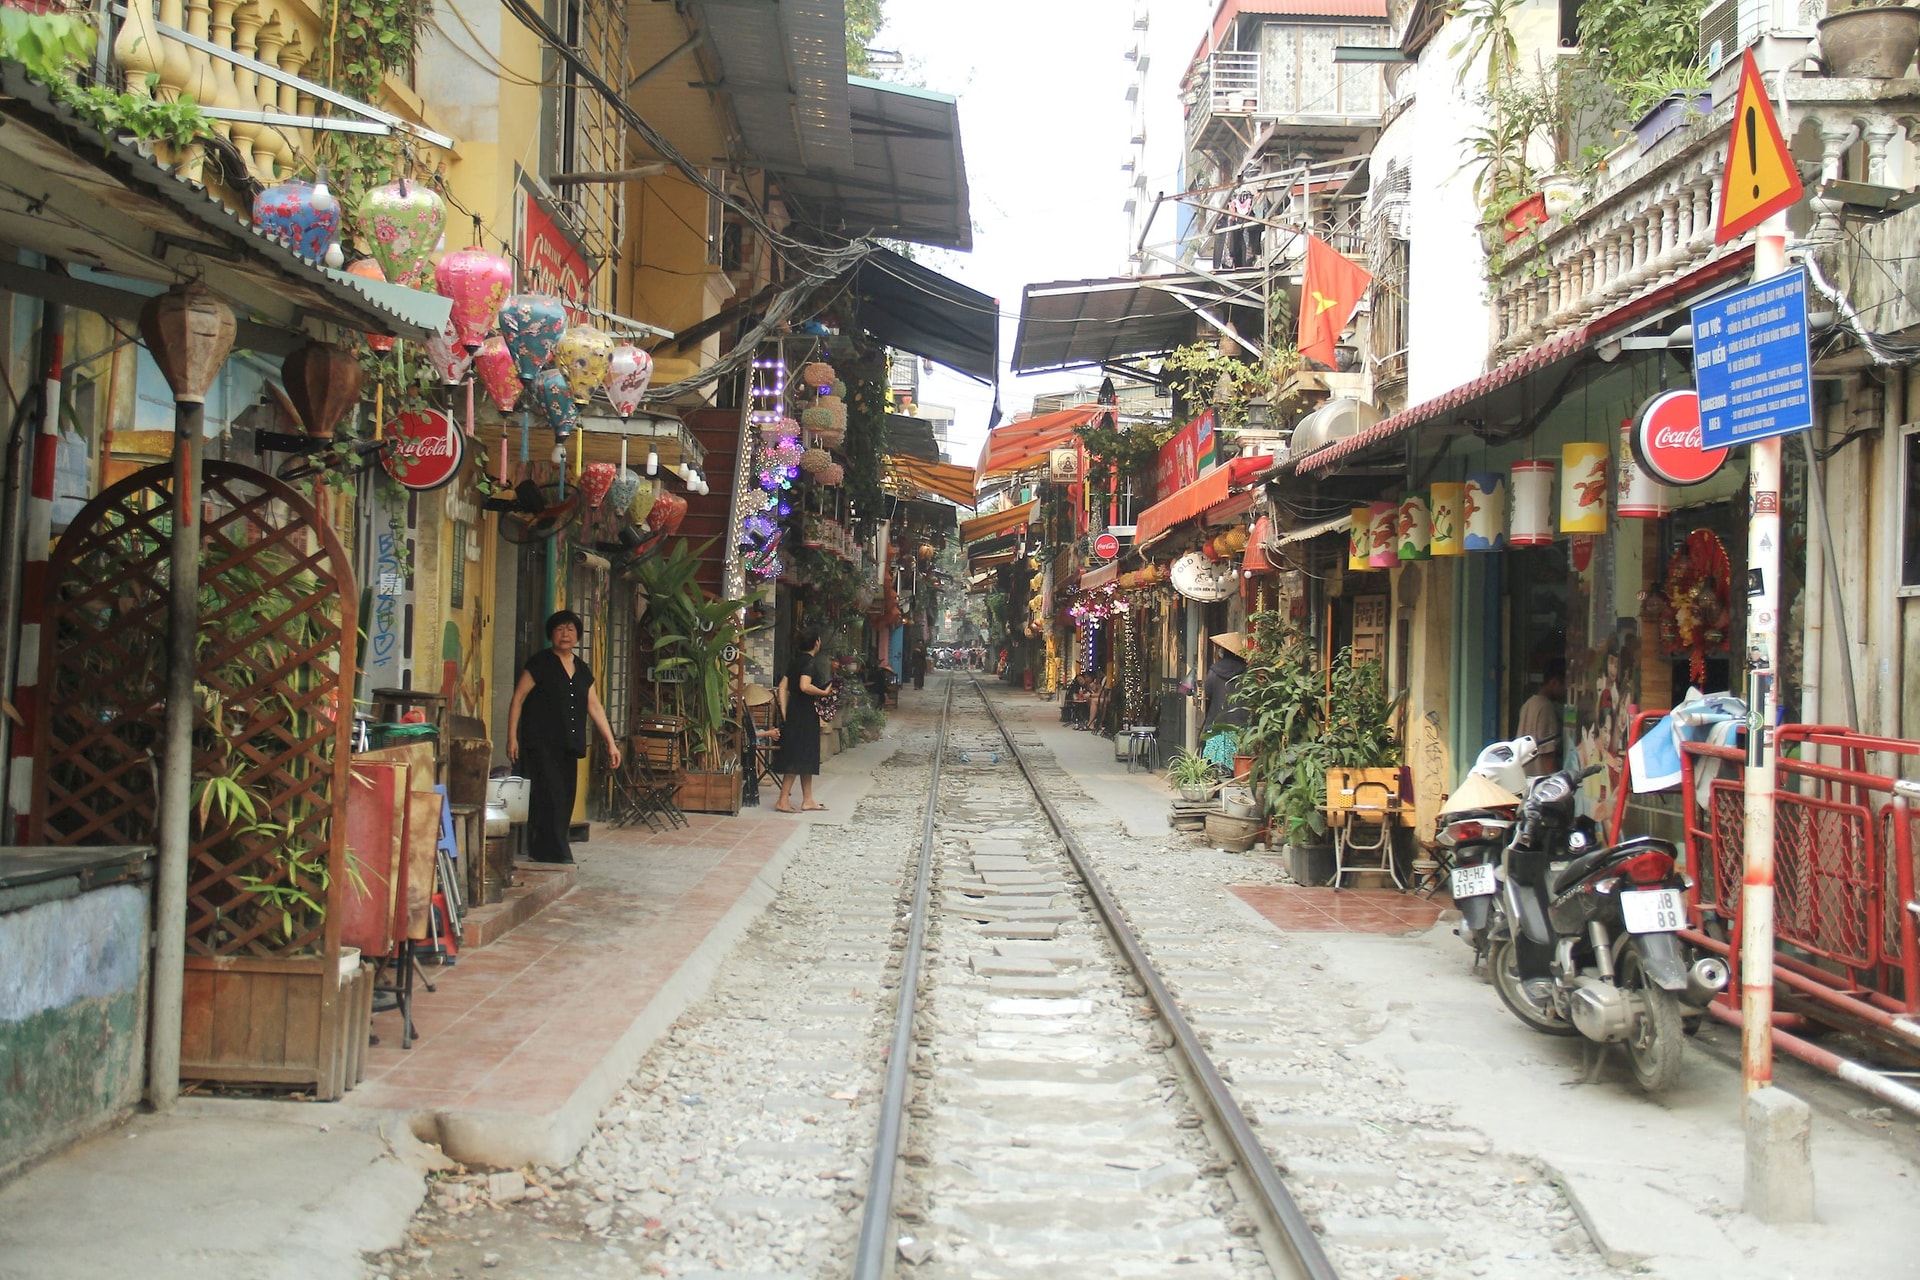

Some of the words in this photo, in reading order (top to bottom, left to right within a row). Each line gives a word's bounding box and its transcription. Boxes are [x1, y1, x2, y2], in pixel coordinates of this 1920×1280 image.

[543, 237, 562, 270] DRINK
[1700, 394, 1726, 412] DANGEROUS
[1708, 416, 1720, 430] AREA
[1654, 426, 1701, 448] Coca-Co
[1097, 542, 1116, 550] Coca-Cola
[1177, 558, 1194, 574] OLD
[1457, 866, 1486, 883] 29-H2
[1455, 880, 1490, 897] 315.3
